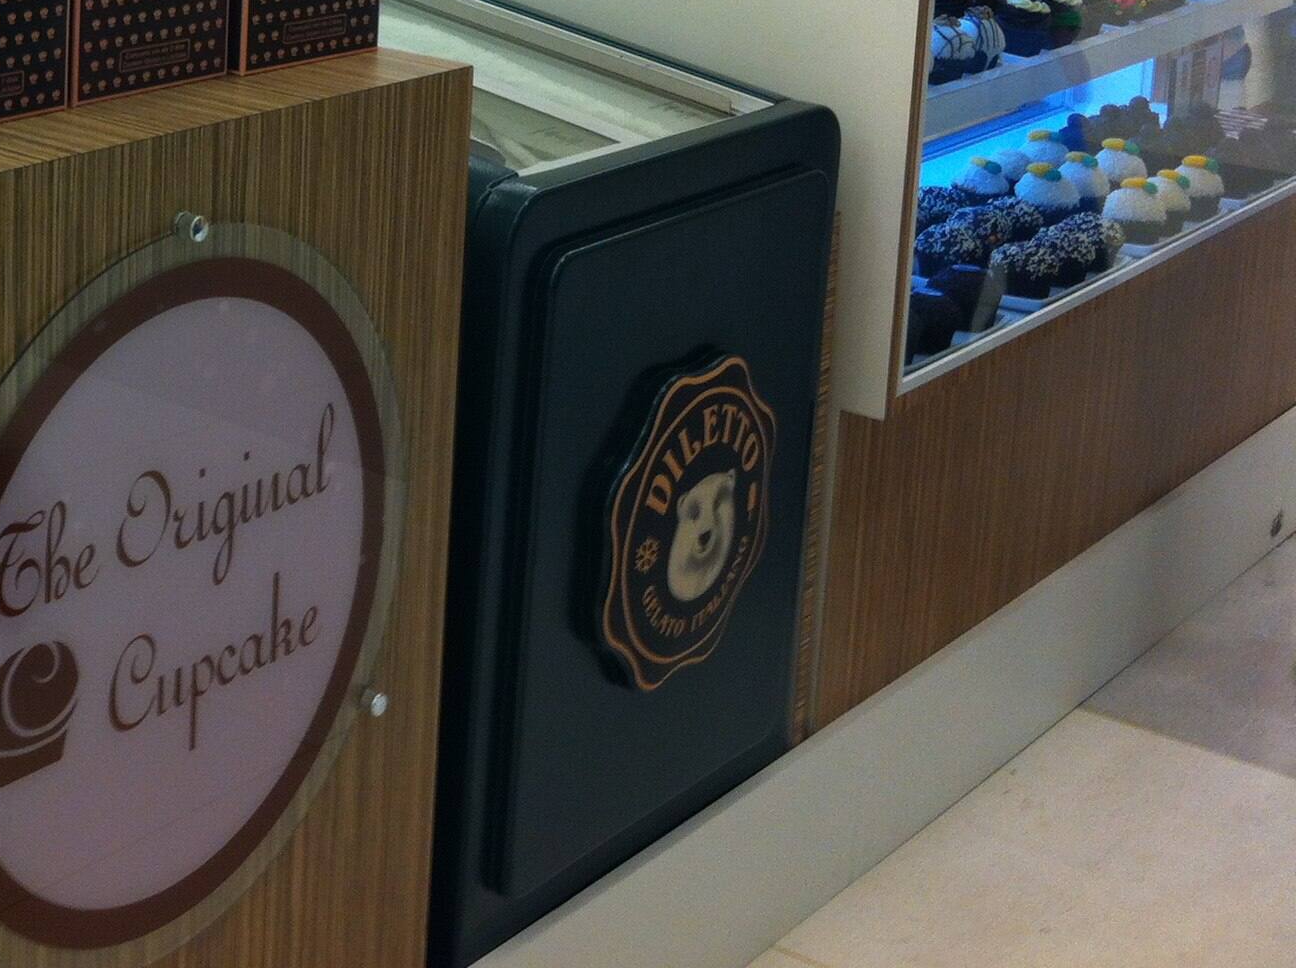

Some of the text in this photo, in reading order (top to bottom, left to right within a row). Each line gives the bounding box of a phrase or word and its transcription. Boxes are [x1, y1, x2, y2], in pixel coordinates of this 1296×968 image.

[116, 402, 335, 586] Original
[646, 404, 760, 516] DILETTO
[108, 572, 318, 751] Cupcake
